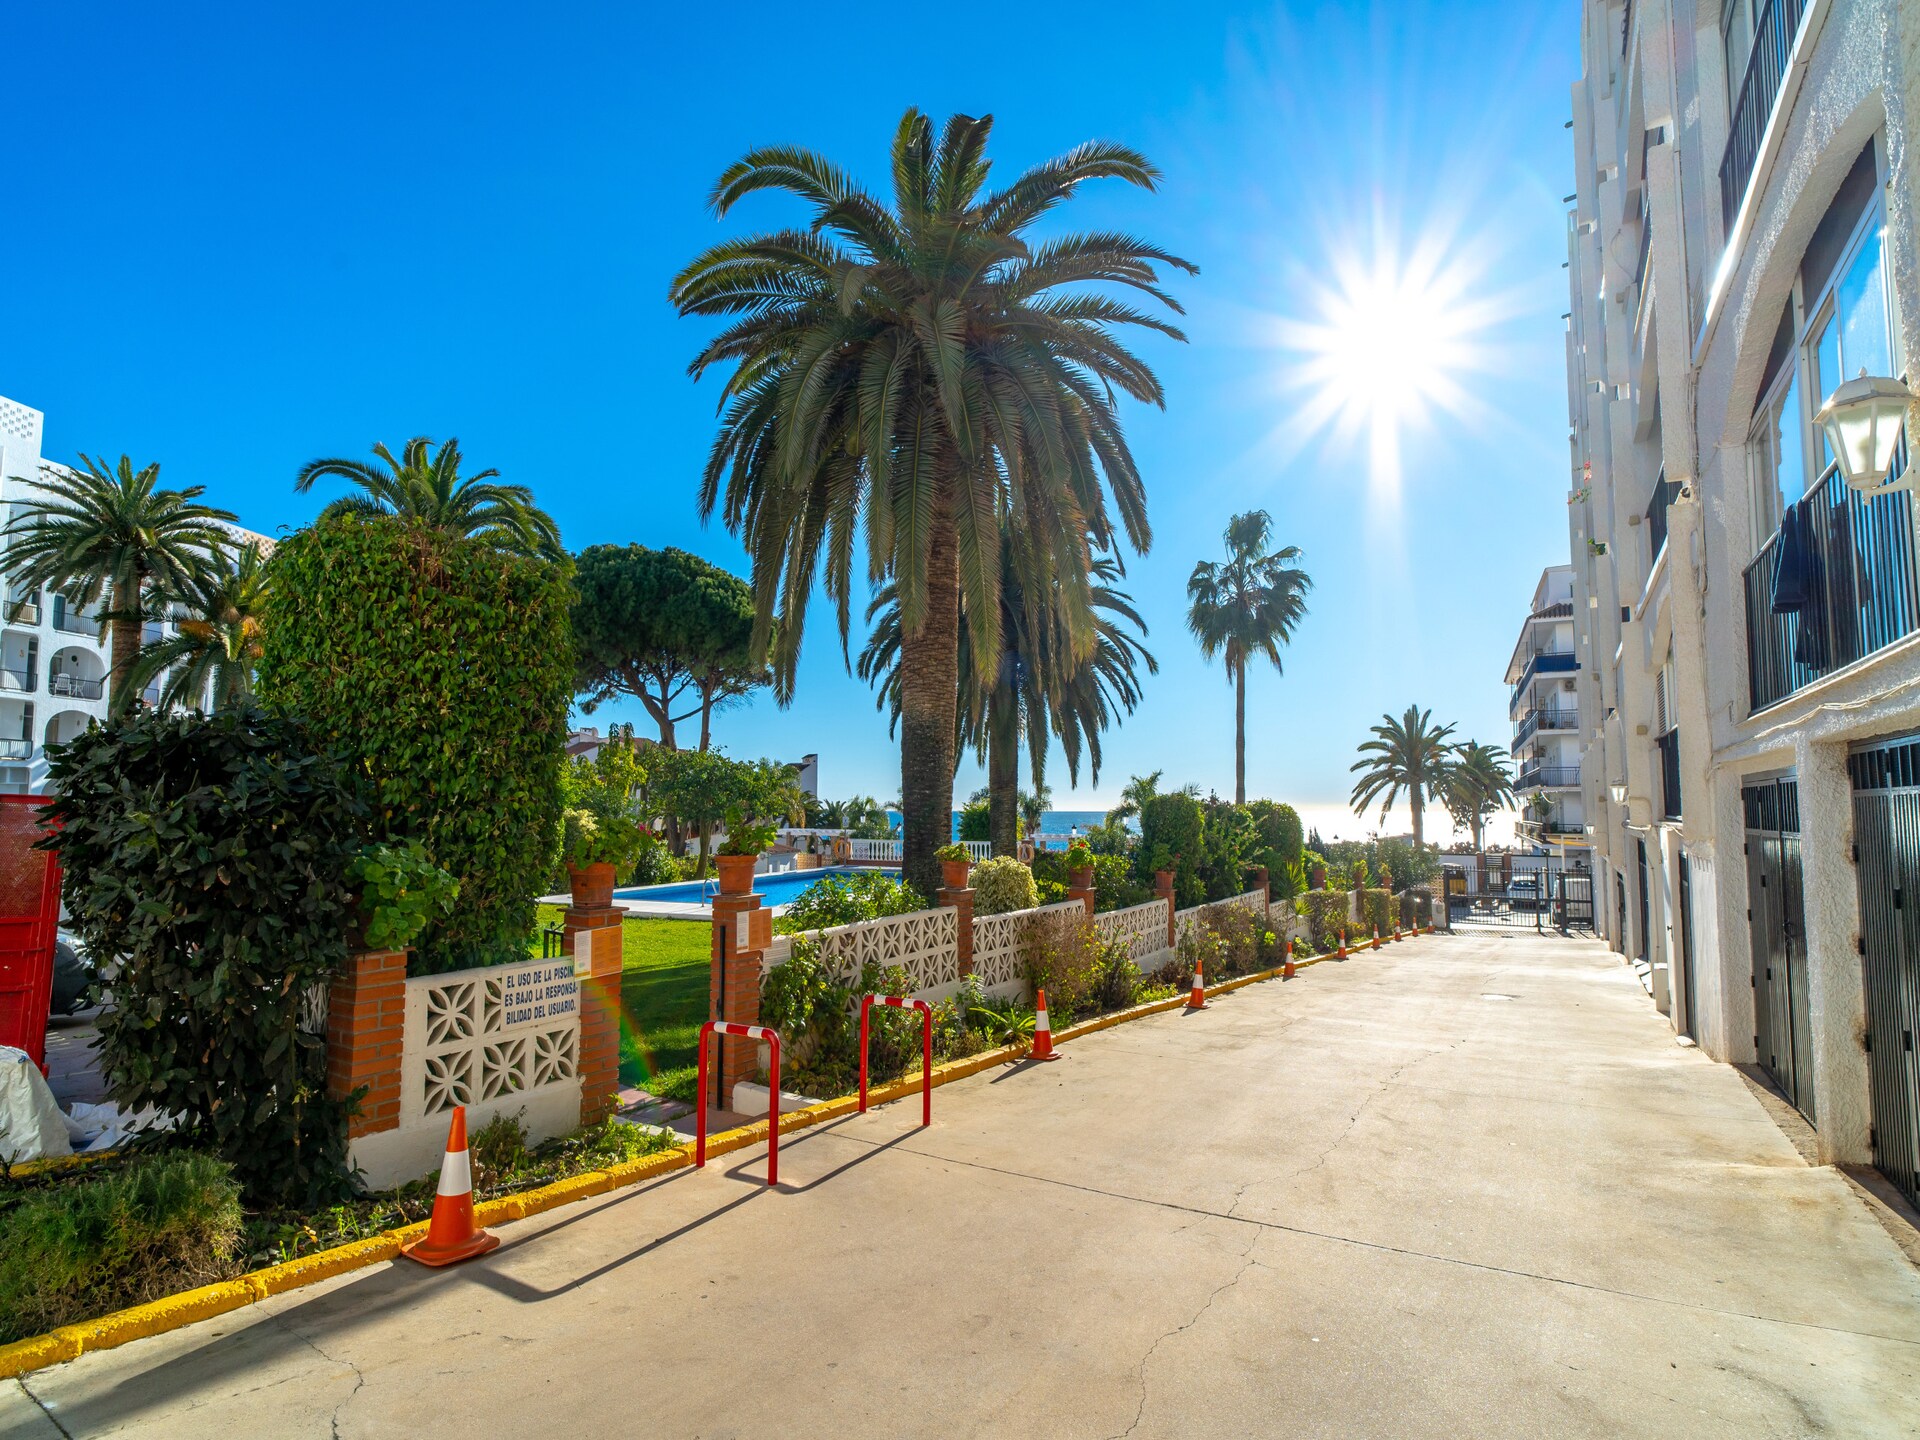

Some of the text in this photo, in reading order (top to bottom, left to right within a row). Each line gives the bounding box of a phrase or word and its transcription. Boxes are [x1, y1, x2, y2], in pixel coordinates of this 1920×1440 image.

[507, 966, 574, 988] EL USO DE LA PISCIN
[505, 982, 578, 1007] ES BAJO LA RESPONSA-
[507, 999, 576, 1025] BILIDAD DEL USUARIO.
